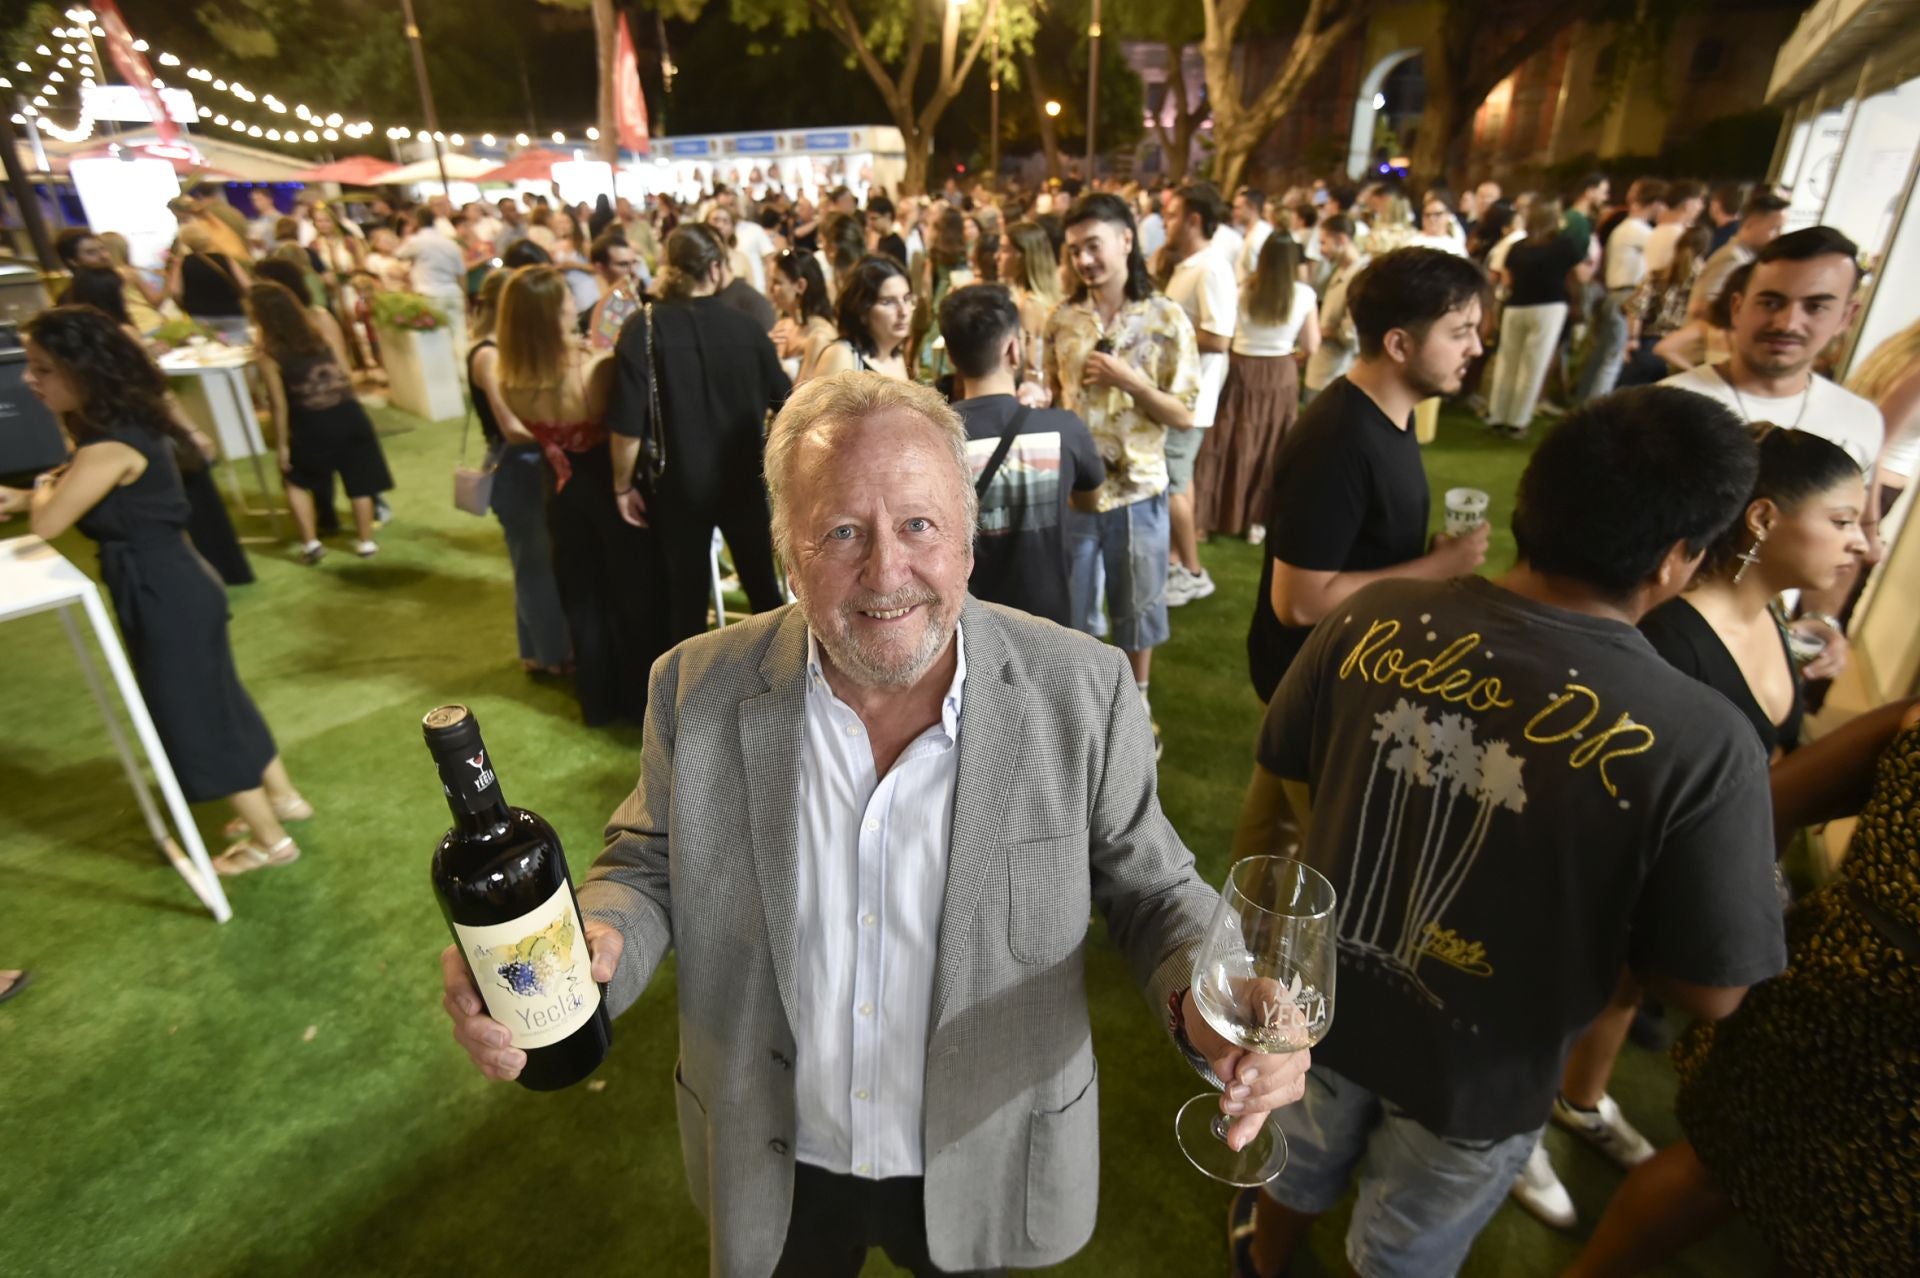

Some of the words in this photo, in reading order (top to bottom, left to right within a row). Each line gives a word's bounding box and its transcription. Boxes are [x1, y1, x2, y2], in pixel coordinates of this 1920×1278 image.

[1339, 618, 1514, 712] Rodeo
[1523, 683, 1656, 798] DR
[515, 992, 576, 1030] Yecla
[1262, 997, 1326, 1029] YECLA
